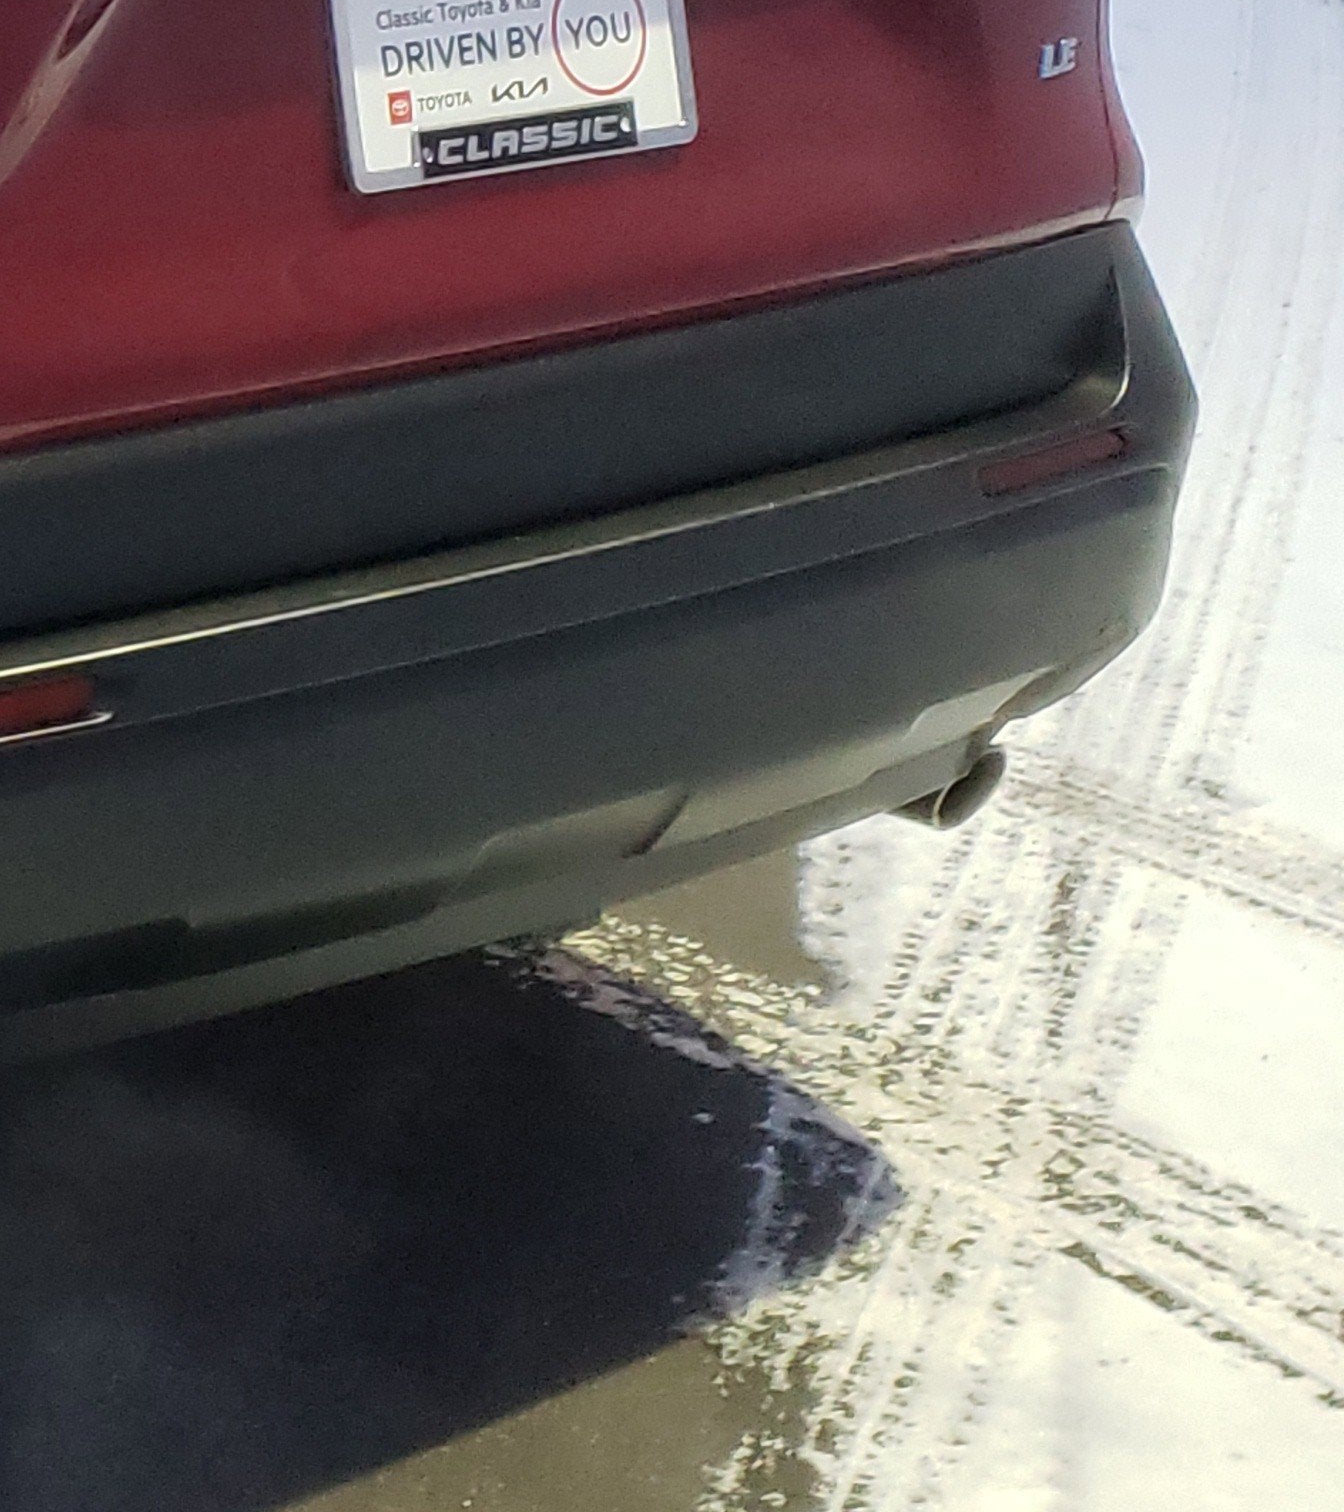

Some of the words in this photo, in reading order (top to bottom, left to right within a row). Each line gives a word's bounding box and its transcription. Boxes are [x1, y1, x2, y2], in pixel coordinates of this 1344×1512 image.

[376, 5, 434, 30] Classic
[380, 29, 498, 78] DRIVEN
[505, 22, 545, 60] BY
[564, 11, 632, 50] YOU
[1038, 37, 1078, 79] LE
[417, 90, 473, 112] TOYOTA
[437, 114, 619, 166] CLASSIC
